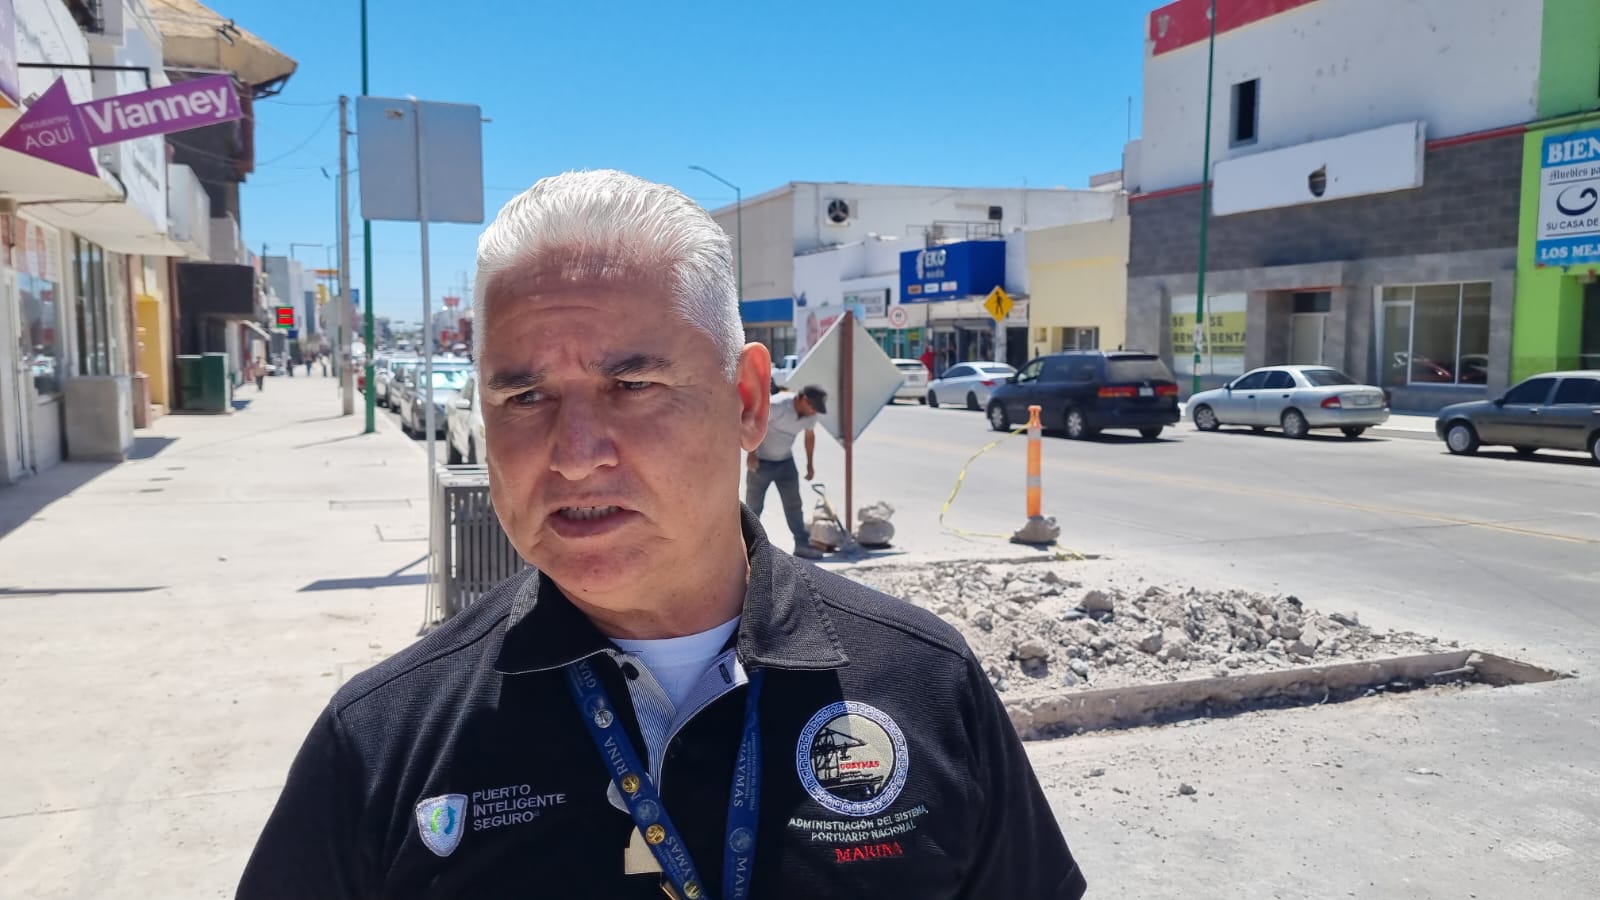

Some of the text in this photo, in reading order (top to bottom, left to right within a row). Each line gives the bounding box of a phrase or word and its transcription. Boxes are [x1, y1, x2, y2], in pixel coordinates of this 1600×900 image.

[84, 86, 228, 134] Vianney
[26, 121, 74, 150] AQUÍ
[1546, 218, 1599, 231] SU CASA DE
[1541, 246, 1568, 260] LOS
[604, 736, 641, 801] MRINA
[472, 784, 531, 803] PUERTO
[473, 793, 567, 817] INTELIGENTE
[473, 810, 534, 831] SEGURO
[788, 817, 874, 831] ADMINISTRACIÓN
[811, 820, 916, 842] PORTUARIO NACIONAL
[835, 841, 903, 863] MARINA
